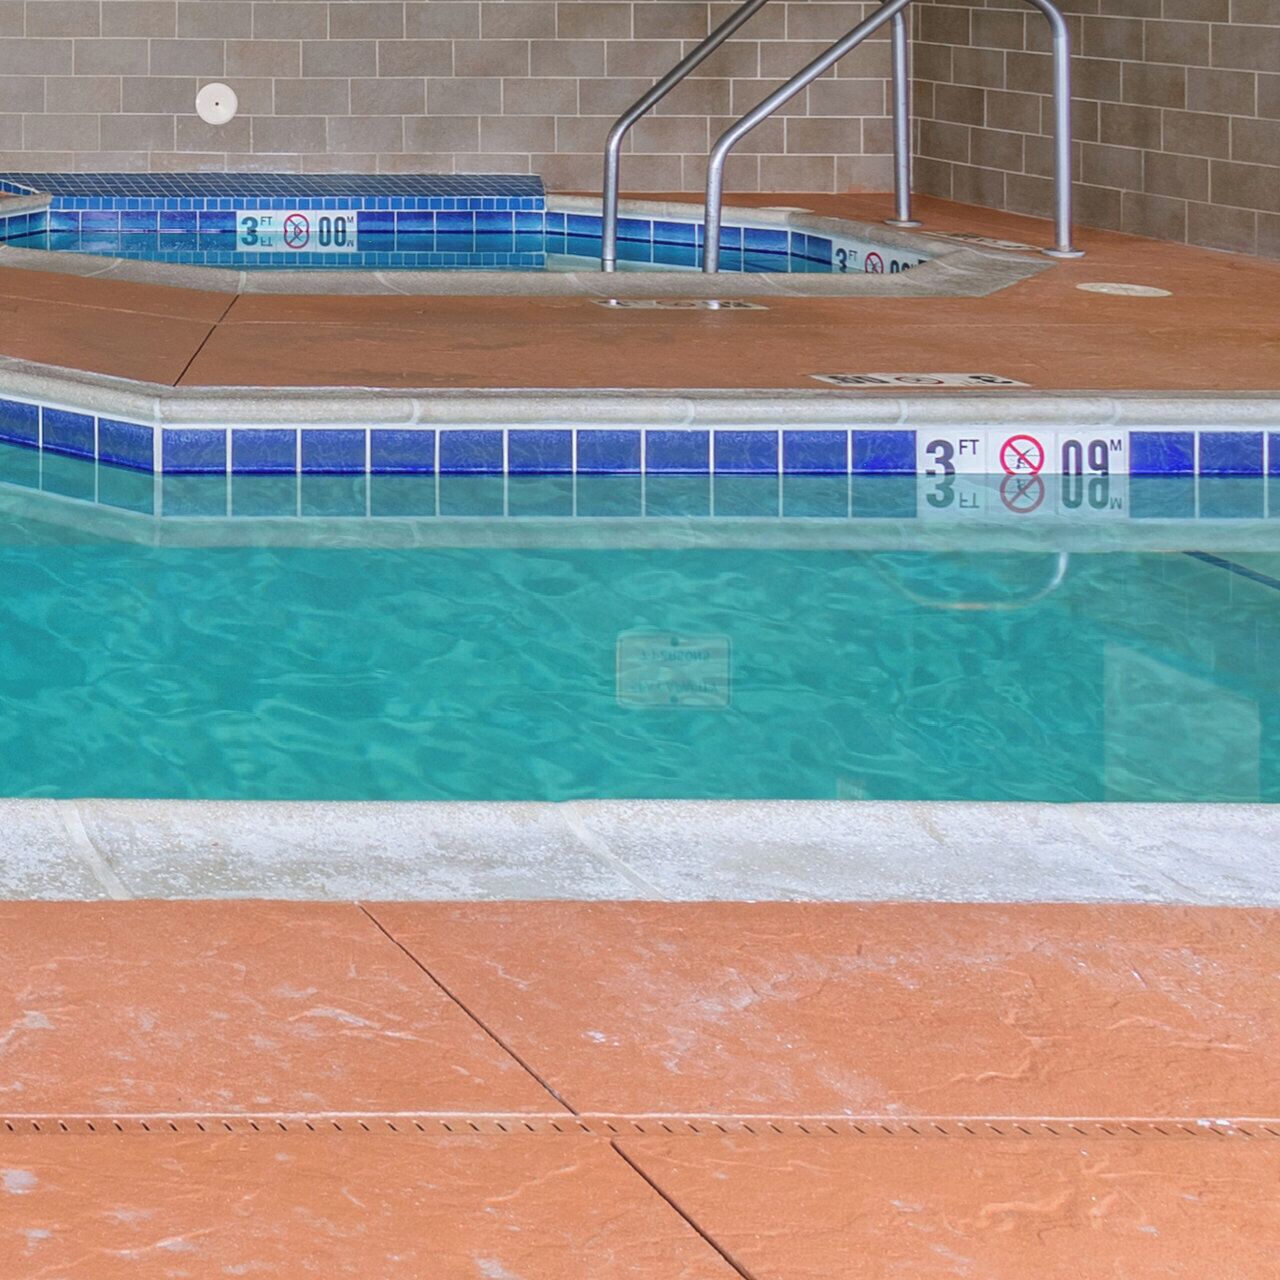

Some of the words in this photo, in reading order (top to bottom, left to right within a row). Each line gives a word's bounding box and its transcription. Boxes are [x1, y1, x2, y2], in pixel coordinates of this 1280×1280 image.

[260, 216, 273, 226] FT
[925, 440, 955, 476] 3
[958, 439, 980, 455] FT
[1110, 439, 1122, 452] M
